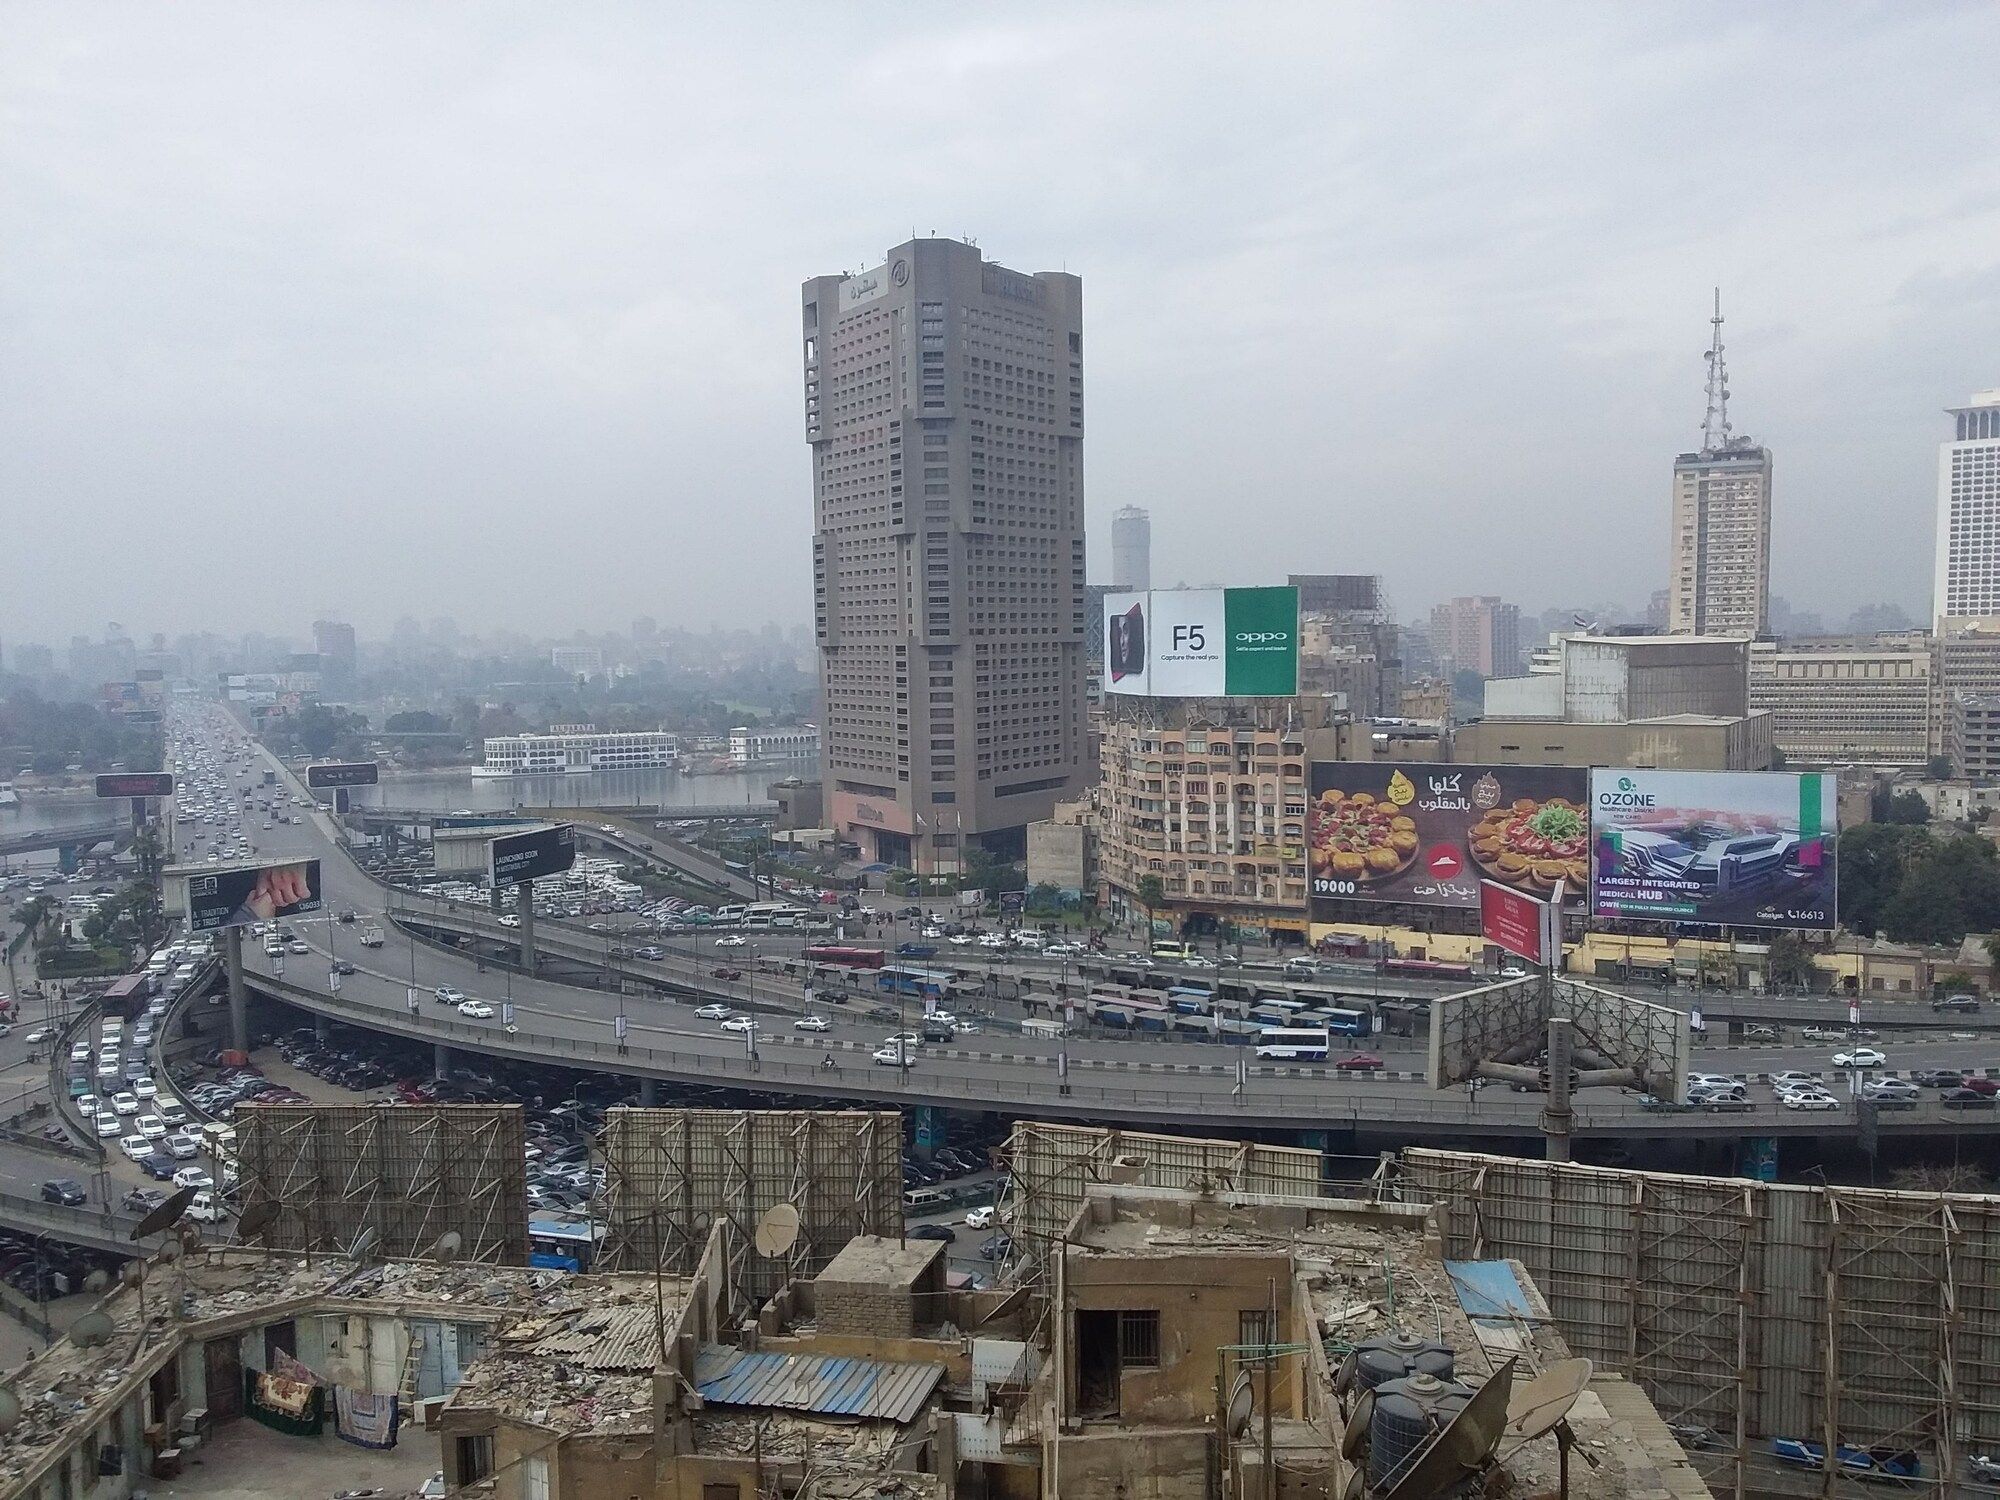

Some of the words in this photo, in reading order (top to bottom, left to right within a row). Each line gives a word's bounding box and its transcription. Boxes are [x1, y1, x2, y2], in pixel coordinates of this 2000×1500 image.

[1173, 625, 1205, 651] F5
[1236, 632, 1287, 643] oppo
[1418, 796, 1471, 813] بالمقلوب
[1600, 793, 1655, 806] OZONE
[496, 853, 523, 865] LAUNCHING
[525, 850, 539, 859] SOON
[1314, 879, 1355, 894] 19000
[1600, 877, 1641, 886] LARGEST
[1642, 880, 1700, 889] INTEGRATED
[1600, 891, 1636, 899] MEDICAL
[1638, 890, 1663, 900] HUB
[302, 900, 320, 910] 16033
[201, 906, 229, 917] TRADITION
[1796, 910, 1824, 920] 16613
[193, 920, 202, 929] OF
[203, 917, 220, 927] TRUST
